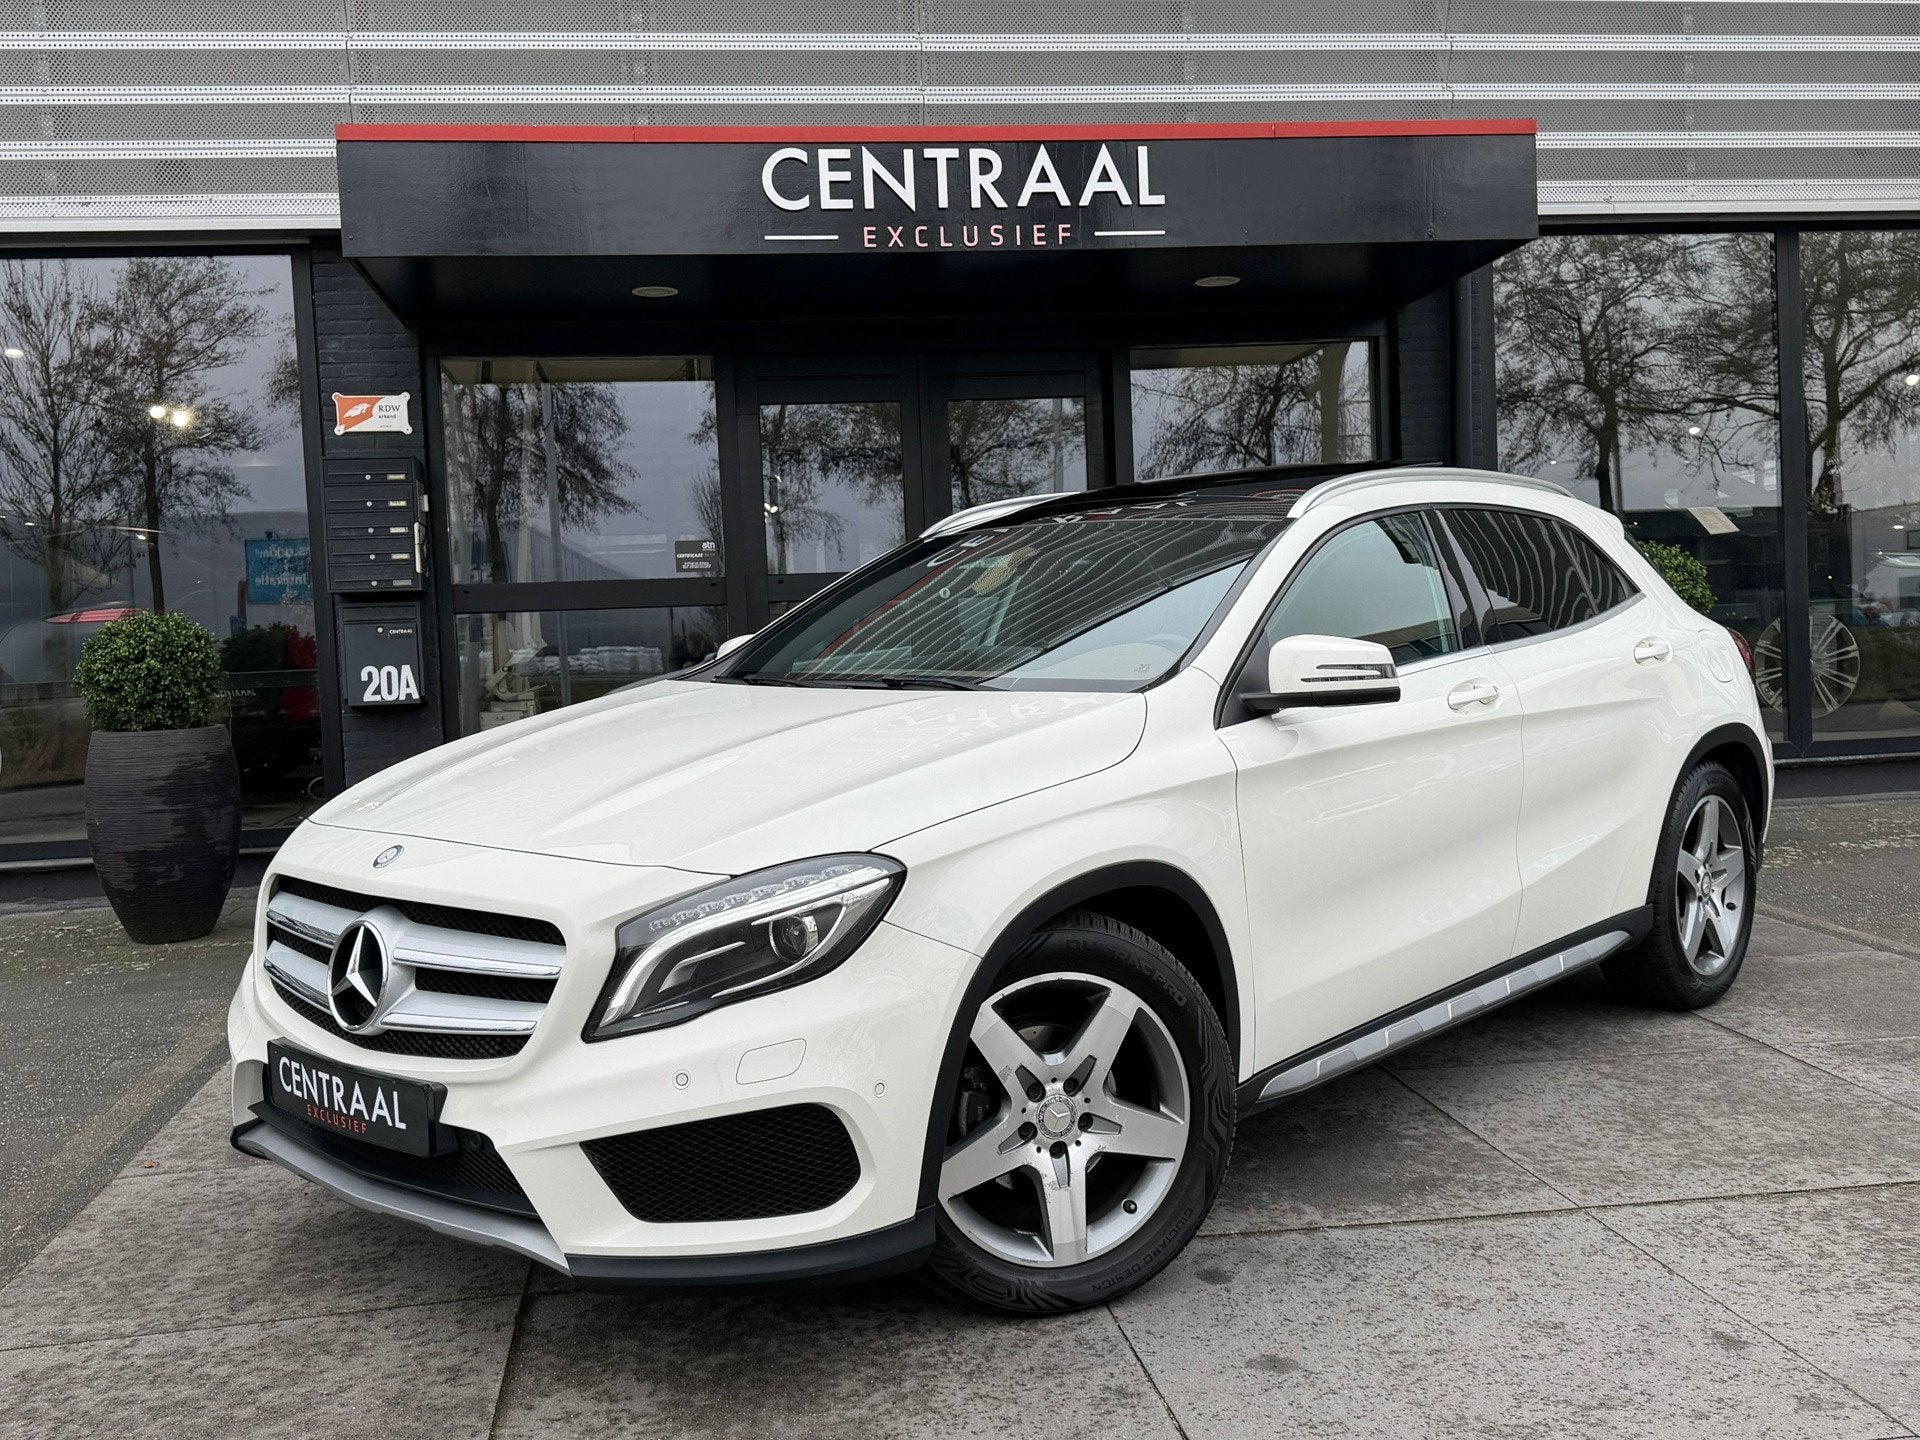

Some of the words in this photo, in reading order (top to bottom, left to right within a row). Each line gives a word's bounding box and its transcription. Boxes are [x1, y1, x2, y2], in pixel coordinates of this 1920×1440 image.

[761, 143, 1166, 212] CENTRAAL
[863, 224, 1072, 248] EXCLUSIEF
[378, 404, 401, 413] RDW
[360, 664, 420, 702] 20A
[1152, 970, 1188, 1007] PRO
[279, 1056, 407, 1130] CENTRAAL
[307, 1104, 368, 1135] EXCLUSIEF
